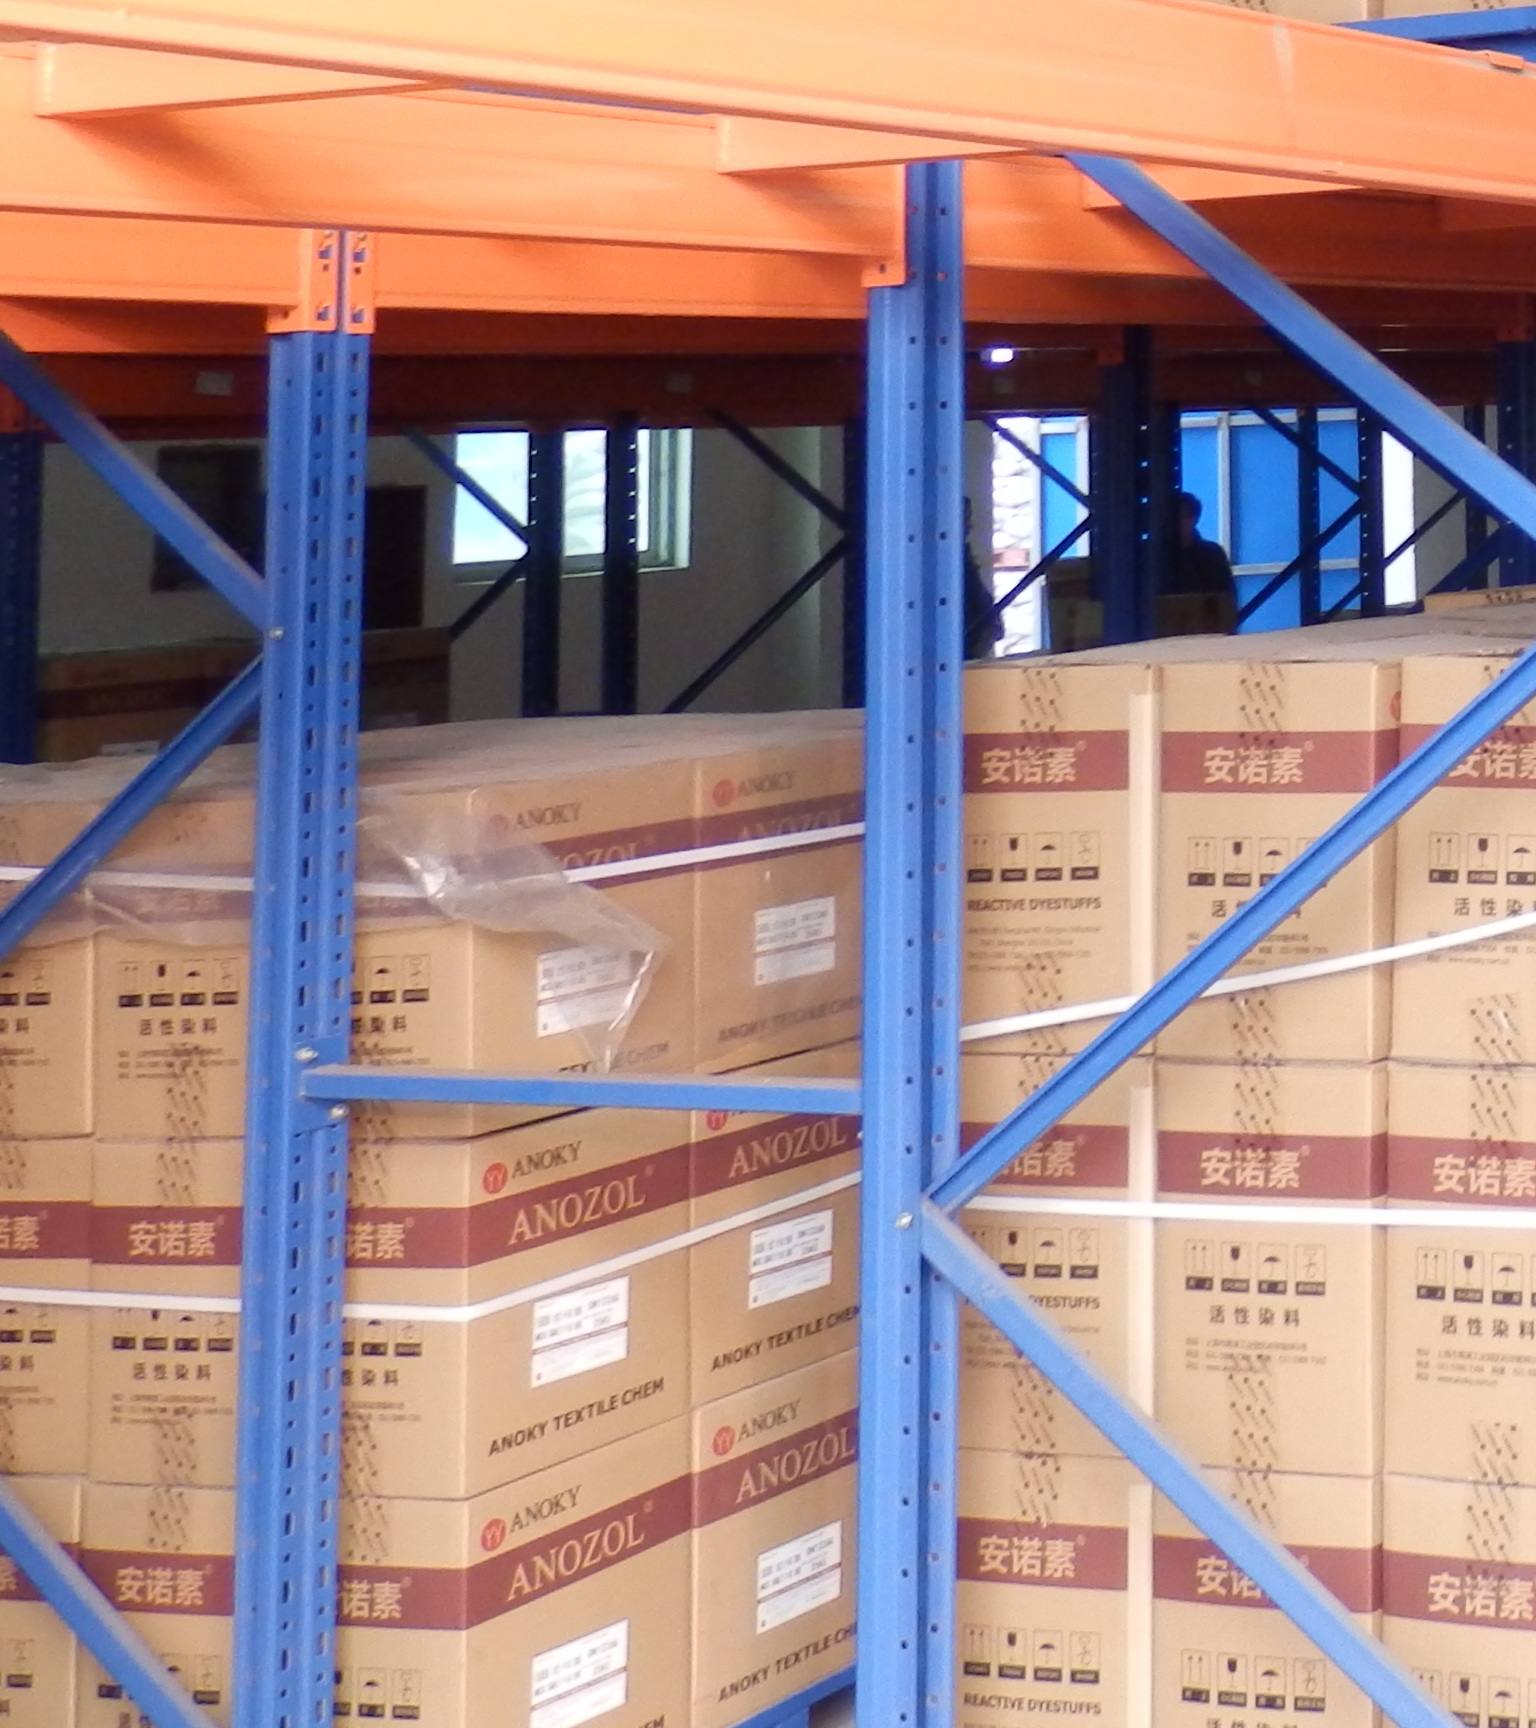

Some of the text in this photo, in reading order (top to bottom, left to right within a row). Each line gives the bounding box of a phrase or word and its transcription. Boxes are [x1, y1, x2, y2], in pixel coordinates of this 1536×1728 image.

[980, 746, 1077, 786] 安诺素
[1202, 746, 1304, 786] 安诺素
[512, 803, 582, 830] ANOKY
[966, 896, 1102, 913] REACTIVE DYESTUFFS
[511, 1140, 583, 1180] ANOKY
[728, 1117, 847, 1178] ANOZOL
[1000, 1142, 1077, 1178] 诺素
[1200, 1146, 1300, 1190] 安诺素
[506, 1173, 646, 1246] ANOZOL
[0, 1217, 40, 1250] 诺素
[128, 1221, 217, 1257] 安诺素
[346, 1222, 406, 1259] 诺素
[1209, 1304, 1300, 1327] 活性染料
[1441, 1315, 1536, 1340] 活性染料
[711, 1339, 764, 1371] ANOKY
[766, 1321, 824, 1352] TEXTILE
[488, 1377, 665, 1457] ANOKY TEXTILE CHEM
[738, 1400, 800, 1442] ANOKY
[736, 1427, 855, 1504] ANOZOL
[508, 1484, 583, 1533] ANOKY
[506, 1515, 646, 1602] ANOZOL
[977, 1533, 1075, 1579] 安诺素
[1195, 1555, 1262, 1597] 安诺
[117, 1565, 205, 1606] 安诺素
[341, 1580, 403, 1619] 诺素
[1427, 1572, 1535, 1621] 安诺素
[718, 1619, 860, 1703] ANOKY TEXTILE CHE
[963, 1692, 1102, 1716] REACTIVE DYESTUFFS
